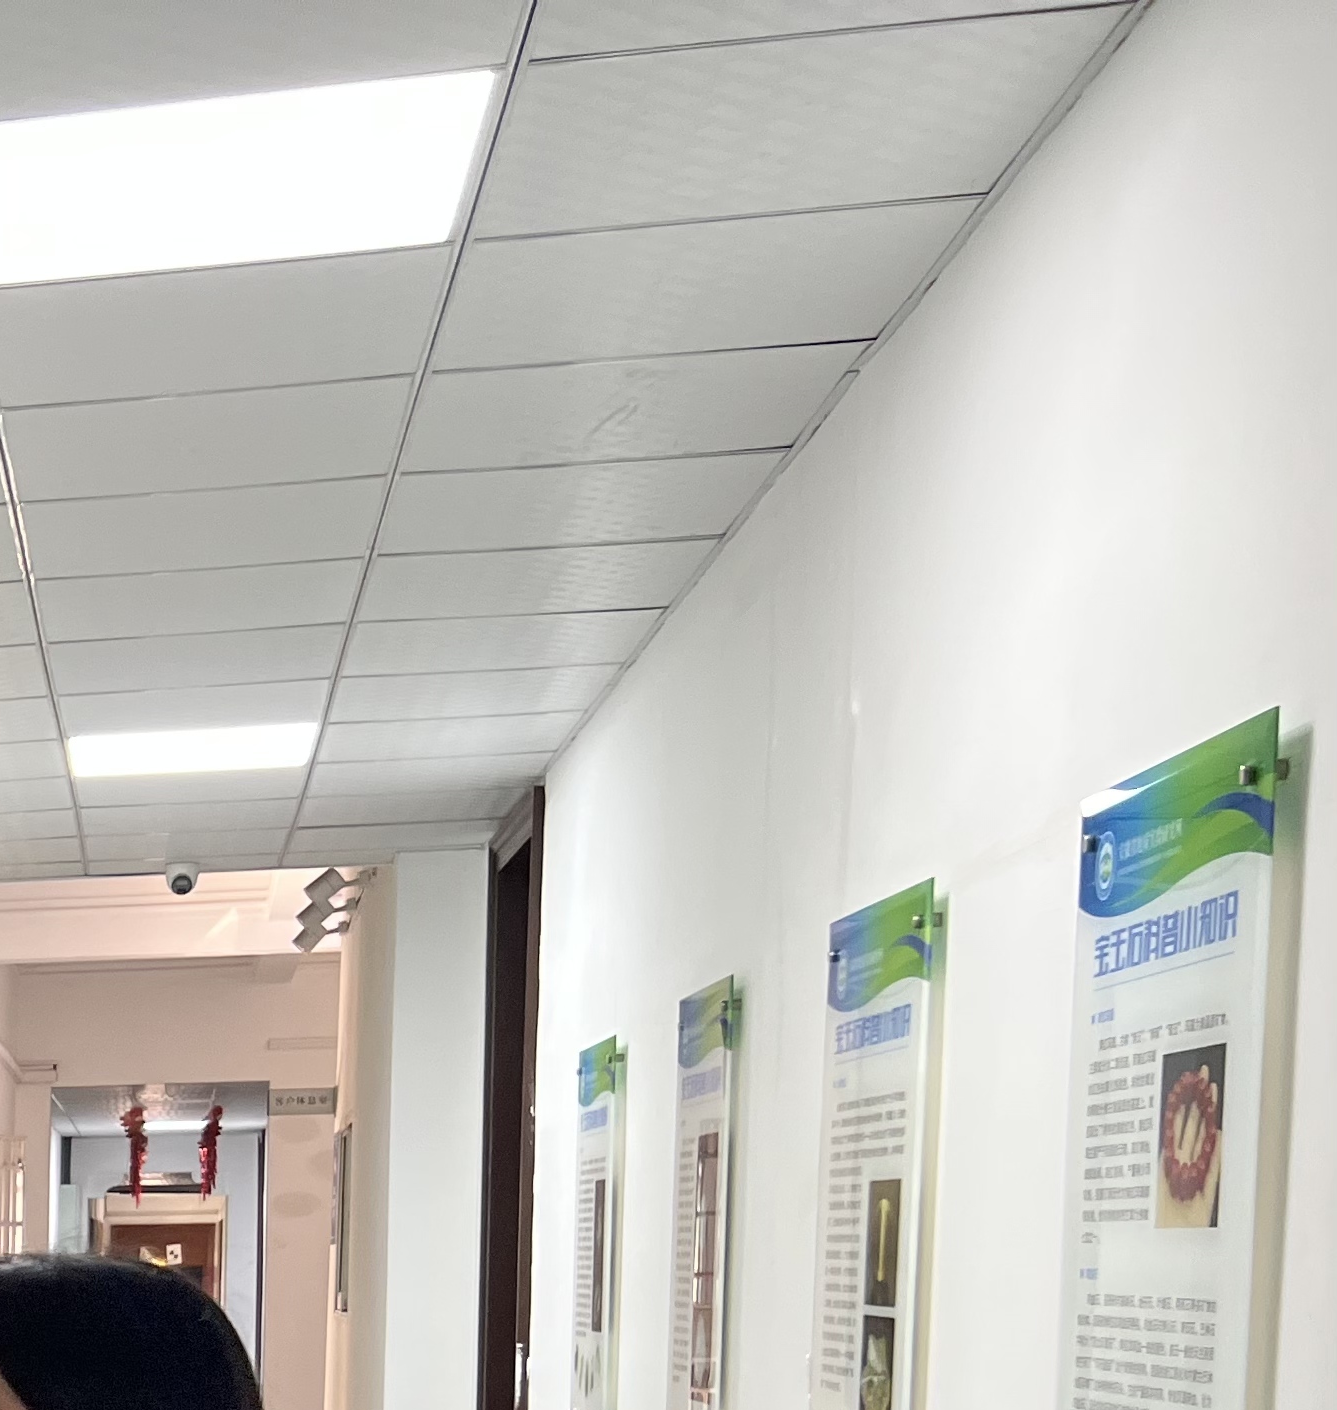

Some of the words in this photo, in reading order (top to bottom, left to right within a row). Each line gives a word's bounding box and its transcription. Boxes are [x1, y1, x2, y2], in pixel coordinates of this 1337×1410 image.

[1093, 890, 1239, 978] 宝玉石科普小知识
